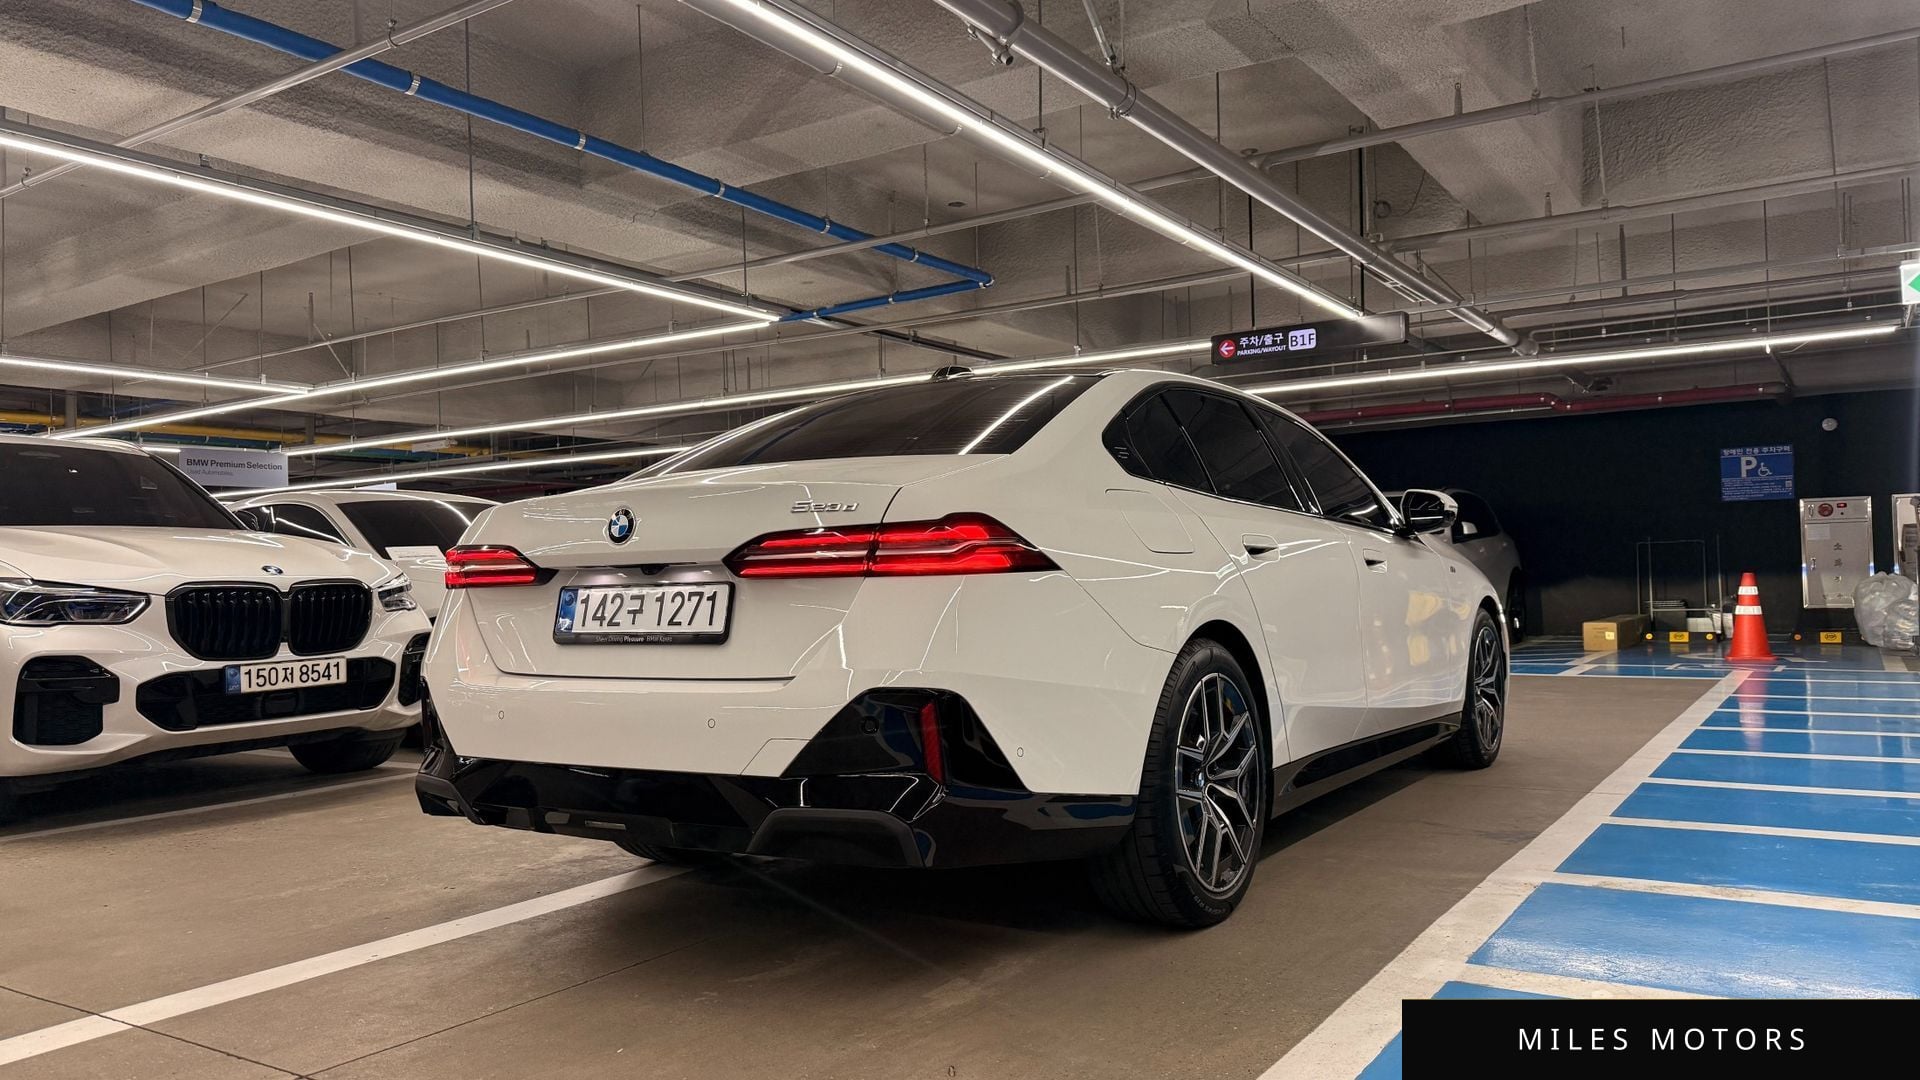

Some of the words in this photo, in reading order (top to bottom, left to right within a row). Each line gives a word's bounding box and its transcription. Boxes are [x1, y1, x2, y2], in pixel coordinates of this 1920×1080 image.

[1239, 332, 1284, 348] 주차/출구
[1290, 333, 1315, 348] B1F
[186, 458, 209, 467] BMW
[210, 459, 246, 469] Premium
[246, 461, 283, 470] Selection
[1740, 456, 1758, 478] P
[580, 592, 646, 627] 142구
[655, 590, 718, 627] 1271
[244, 666, 294, 689] 150저
[299, 661, 340, 684] 8541
